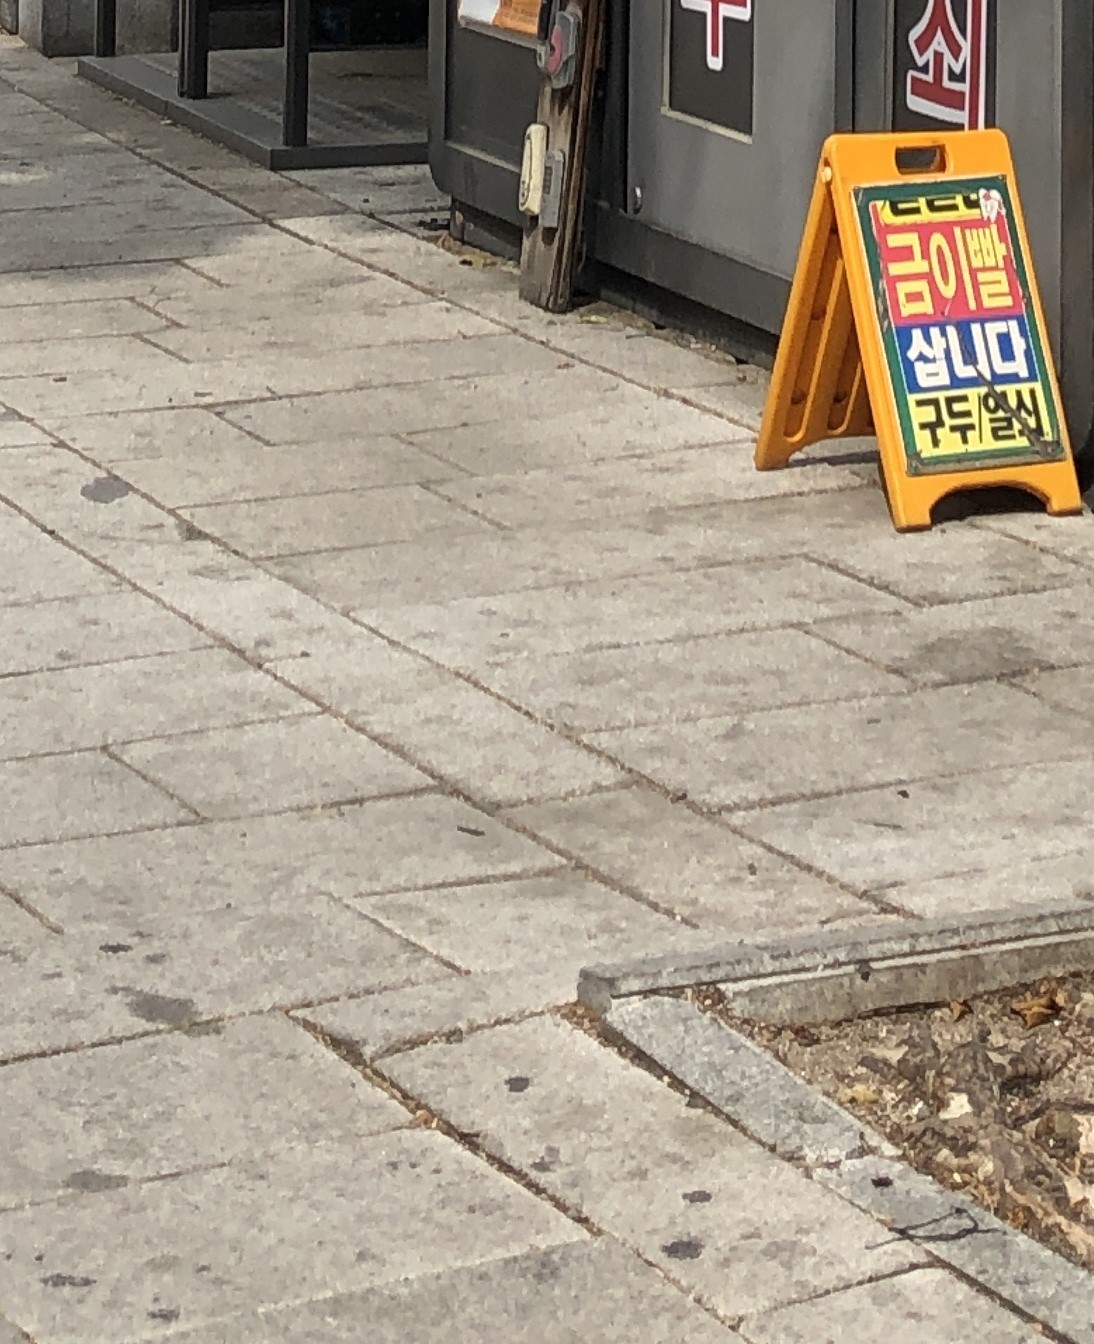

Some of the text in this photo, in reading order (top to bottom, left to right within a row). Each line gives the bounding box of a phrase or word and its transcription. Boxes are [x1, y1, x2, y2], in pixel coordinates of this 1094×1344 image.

[886, 223, 1014, 318] 금이빨
[907, 319, 1030, 388] 삽니다
[915, 388, 1045, 449] 구두/열쇠
